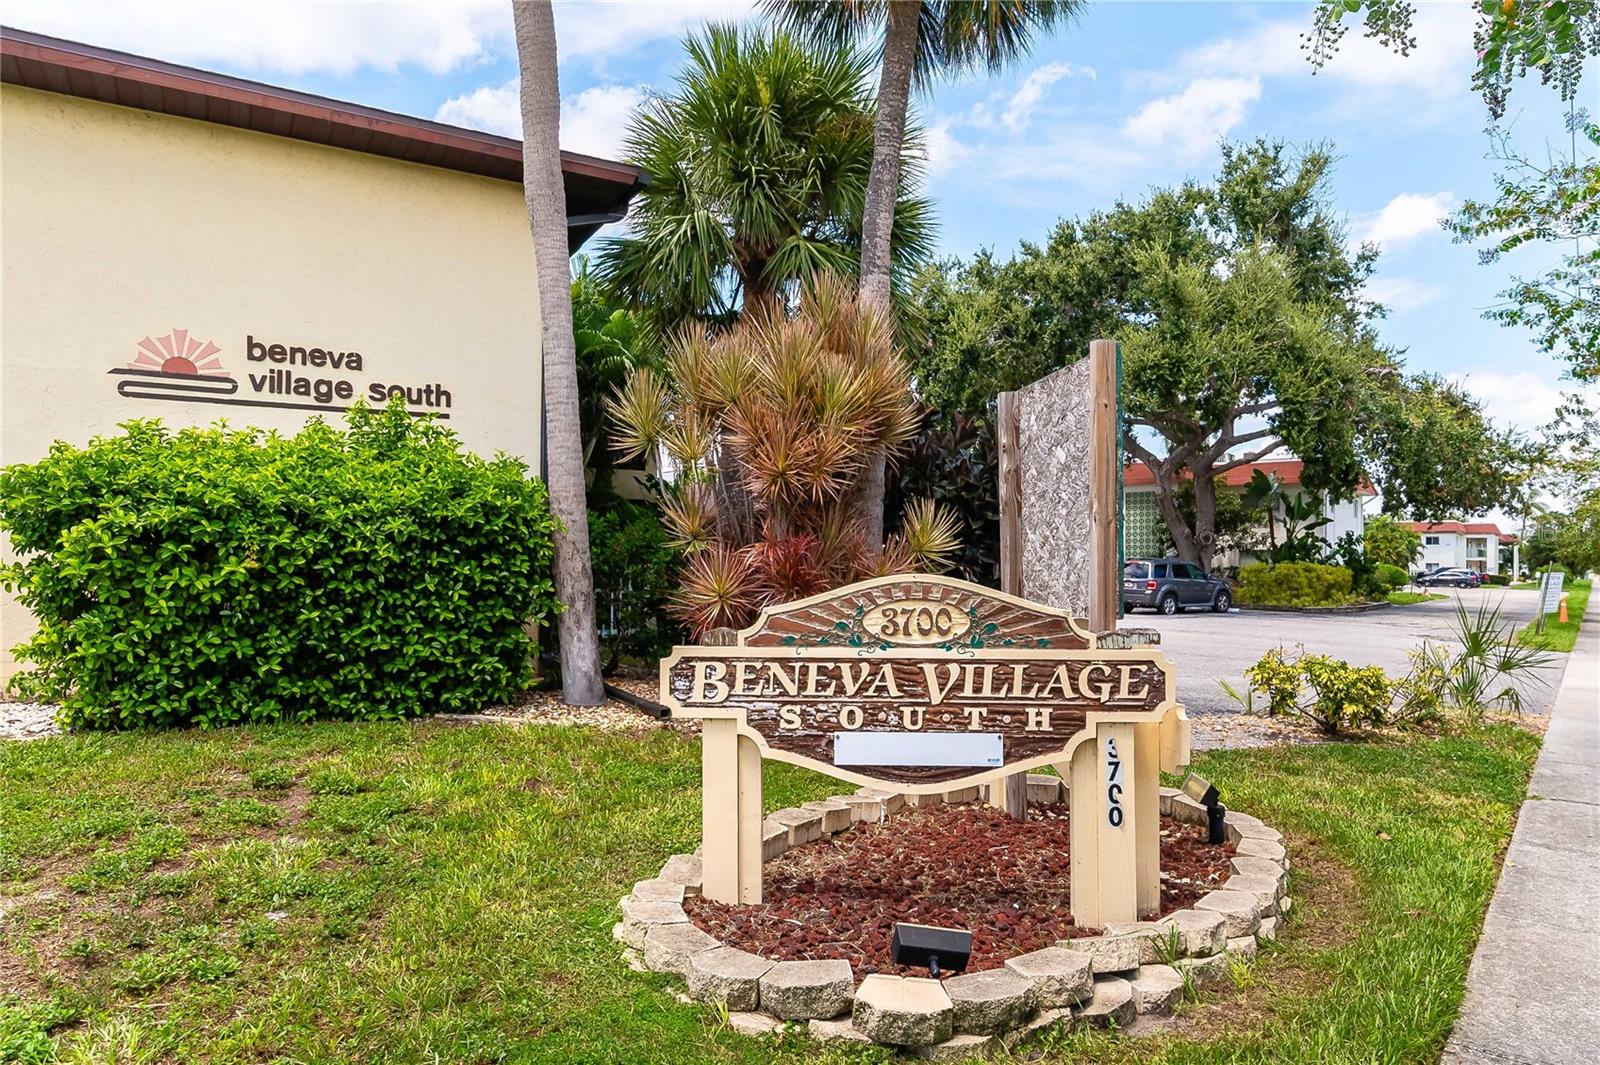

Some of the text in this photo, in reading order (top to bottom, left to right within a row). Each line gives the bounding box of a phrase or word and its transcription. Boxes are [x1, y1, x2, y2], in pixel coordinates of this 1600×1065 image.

[246, 335, 363, 371] beneva
[249, 369, 452, 408] village south
[880, 606, 953, 637] 3700
[688, 660, 1150, 705] BENEVA VILLAGE
